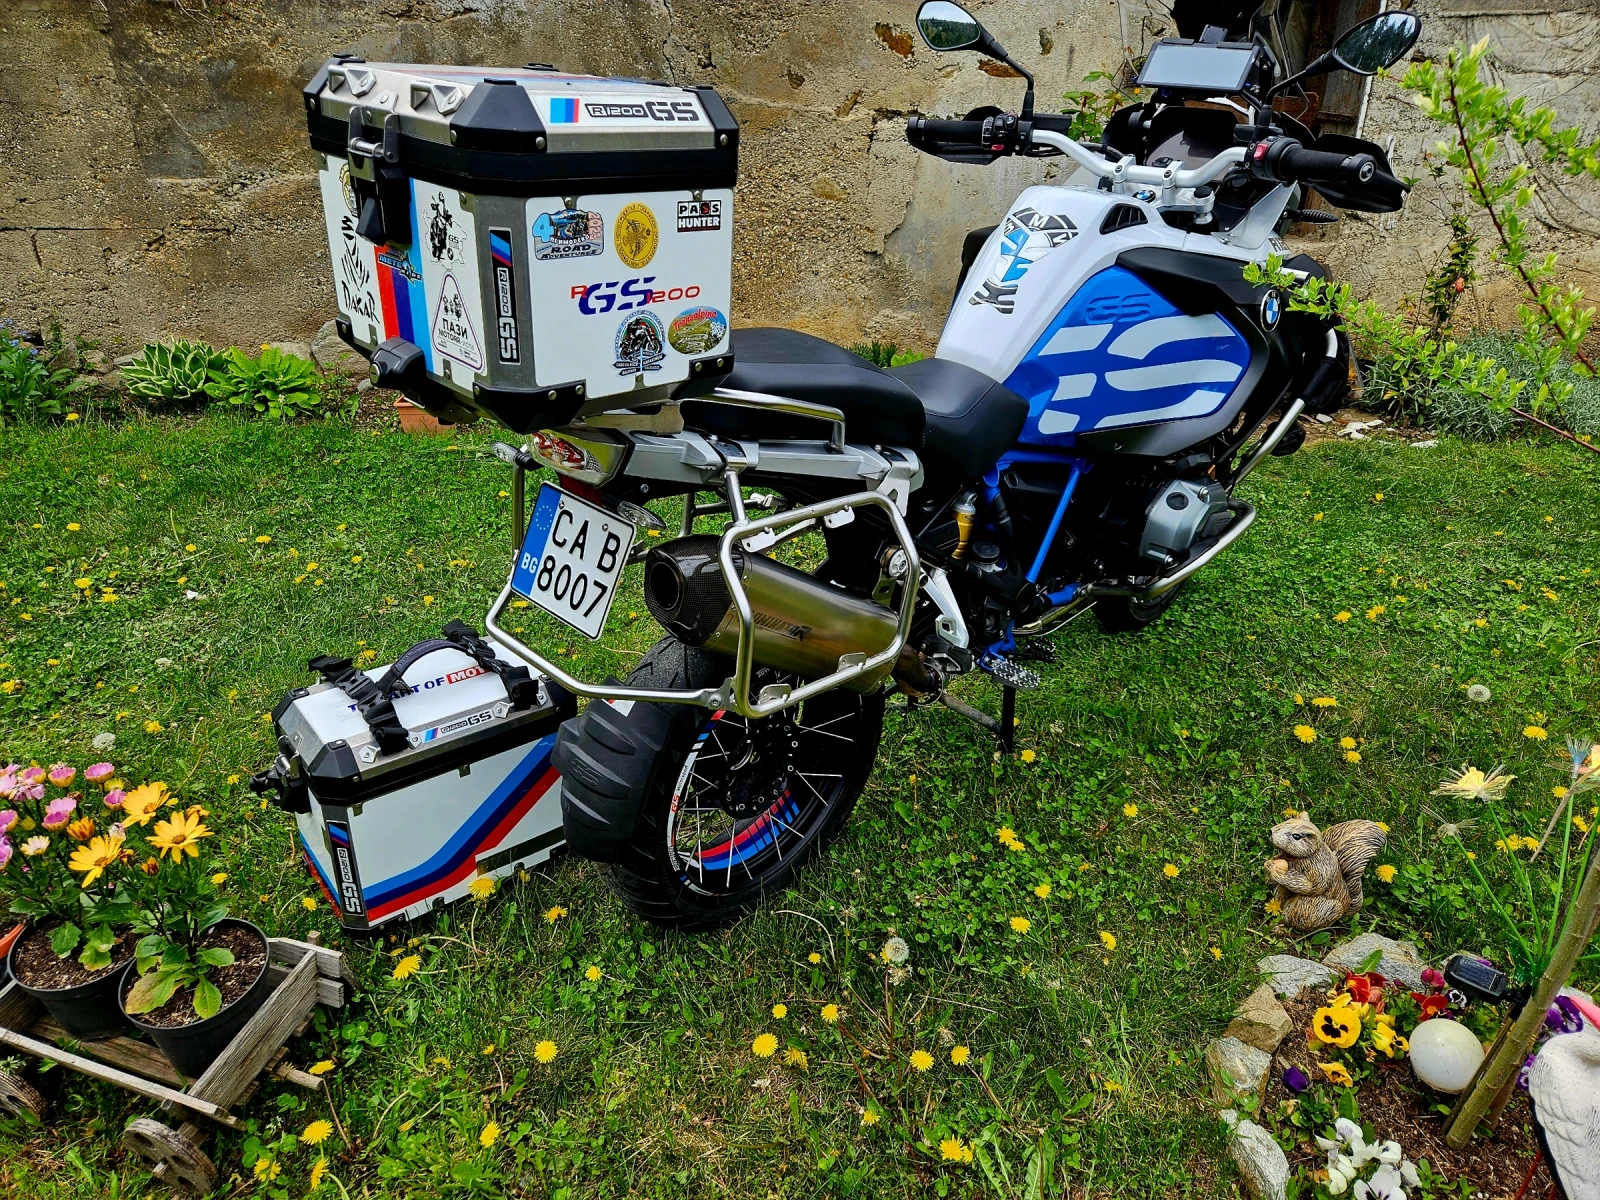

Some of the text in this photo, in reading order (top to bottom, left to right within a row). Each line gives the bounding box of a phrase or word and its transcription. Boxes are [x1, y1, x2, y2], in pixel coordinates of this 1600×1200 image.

[591, 101, 700, 121] R1200 GS
[679, 203, 720, 215] PASS
[533, 213, 554, 243] 4
[678, 216, 719, 229] HUNTER
[448, 234, 460, 244] GS
[551, 245, 592, 254] ROAD
[540, 249, 598, 260] ADVENTURES
[578, 276, 656, 315] GS
[498, 269, 518, 360] R1200 GS
[673, 308, 717, 331] Transalpina
[442, 318, 468, 340] ПАЗИ
[551, 509, 621, 573] CA B
[520, 552, 538, 574] BG
[537, 555, 608, 618] 8007
[424, 677, 446, 690] OF
[468, 711, 493, 726] GS
[342, 882, 361, 913] GS
